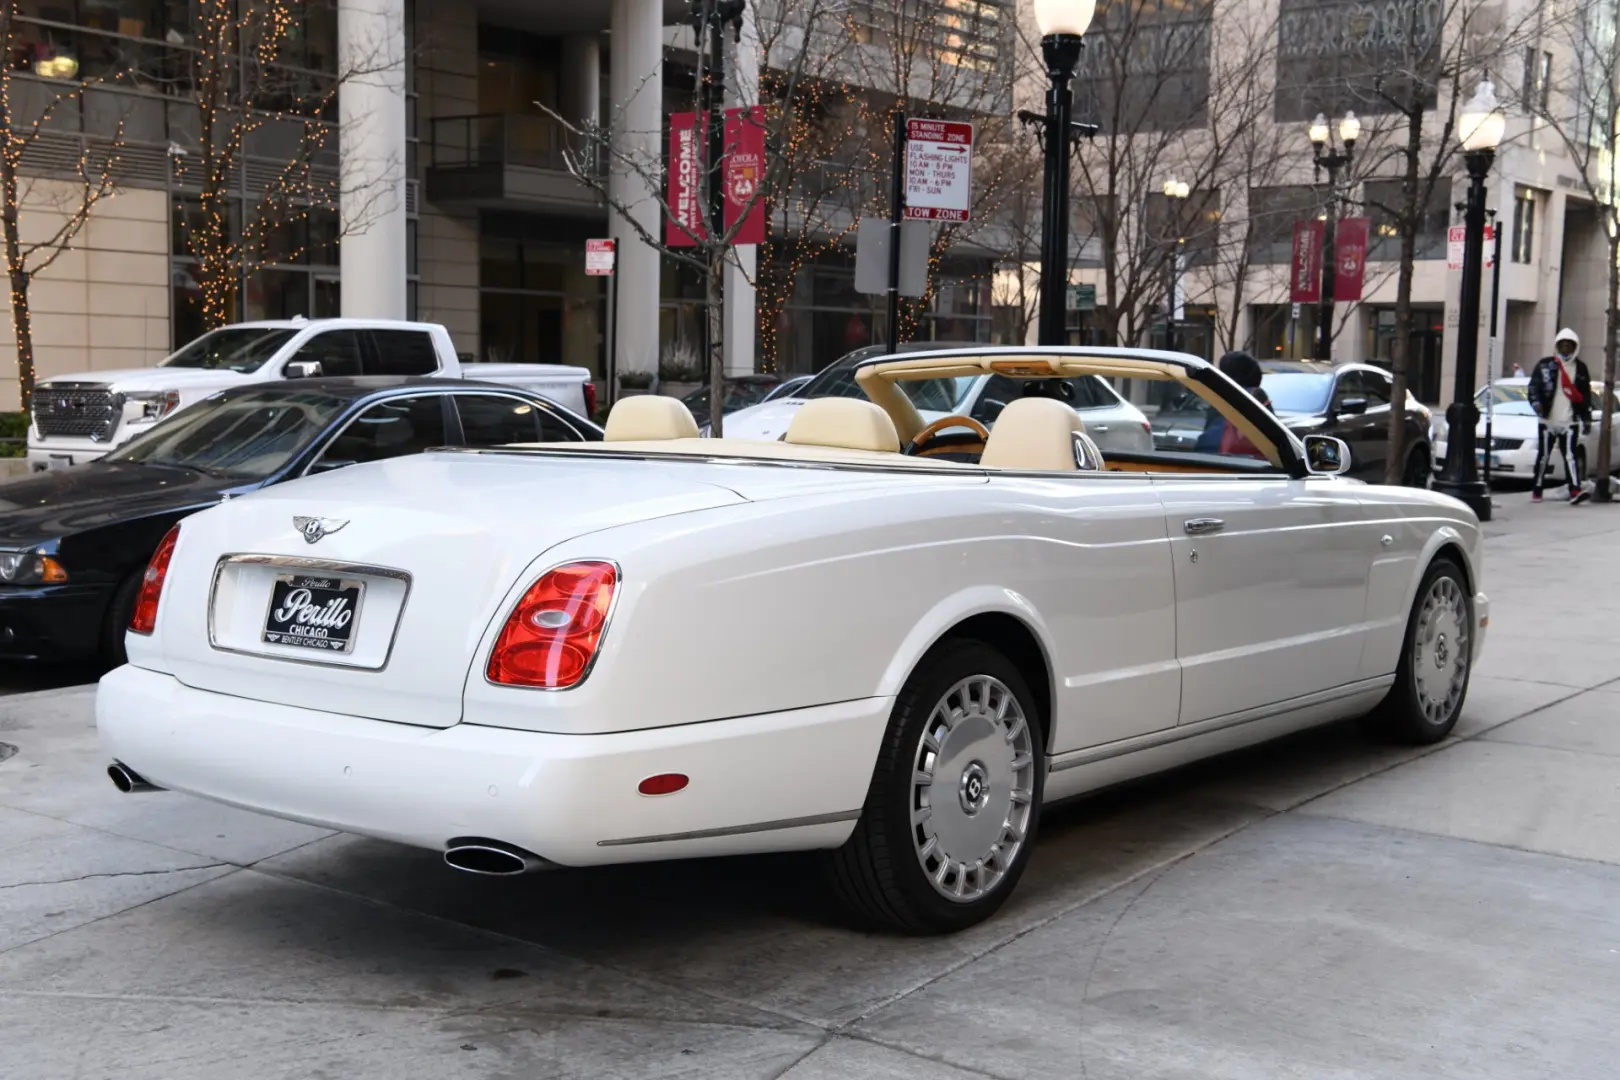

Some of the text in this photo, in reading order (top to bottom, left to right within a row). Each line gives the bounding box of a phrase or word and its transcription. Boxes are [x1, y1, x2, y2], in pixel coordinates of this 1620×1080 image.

[911, 122, 946, 132] 15 MINUTE
[911, 130, 965, 142] STANDING ZONE
[910, 143, 924, 152] USE
[909, 152, 968, 164] FLASHING LIGHTS
[678, 129, 692, 227] WELCOME
[909, 169, 925, 177] MON
[932, 170, 956, 179] THURS
[941, 179, 952, 187] PM
[908, 185, 920, 193] FRI
[926, 186, 942, 194] SUN
[908, 207, 963, 219] TOW ZONE
[301, 577, 331, 588] Perillo
[274, 588, 352, 630] Perillo
[289, 624, 329, 638] CHICAGO
[281, 635, 329, 648] BENTLEY CHICAGO
